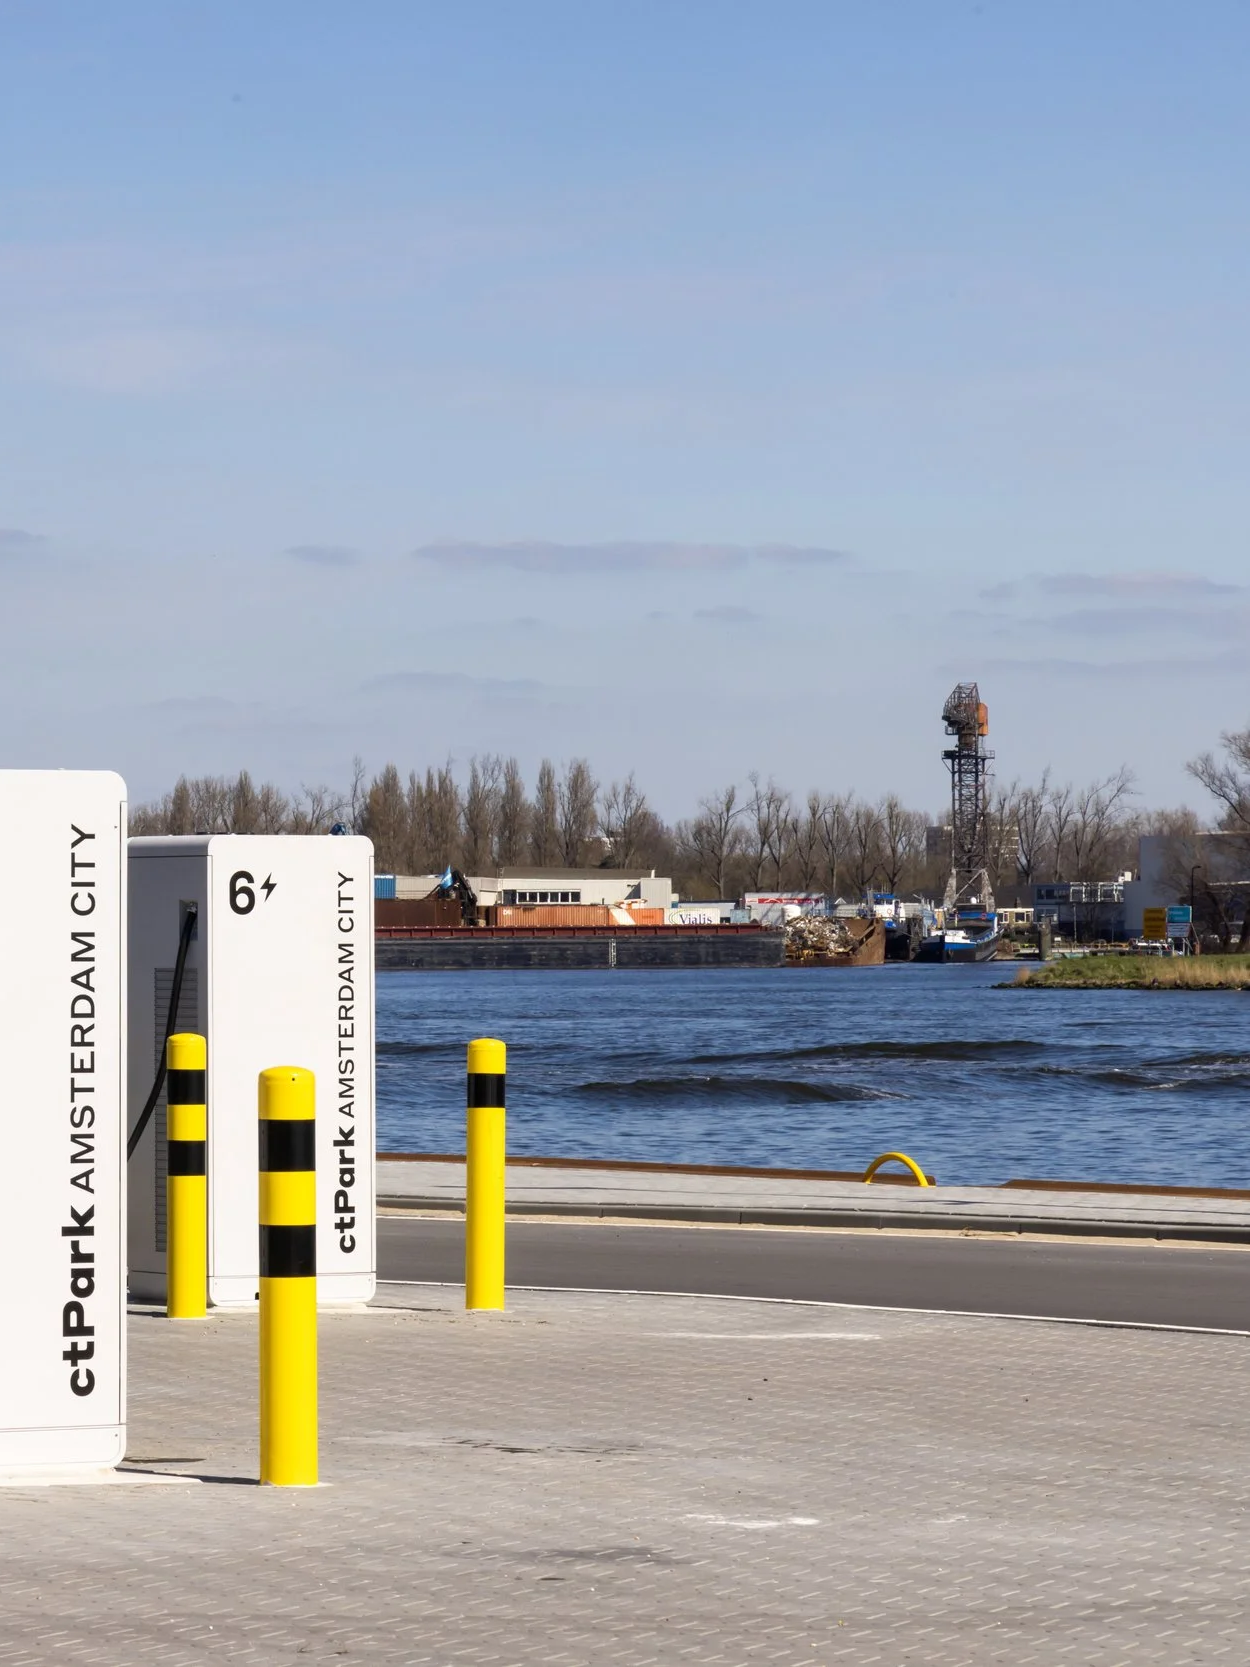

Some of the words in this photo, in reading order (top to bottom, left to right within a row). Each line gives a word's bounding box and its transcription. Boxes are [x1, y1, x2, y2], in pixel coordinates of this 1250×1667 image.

[70, 824, 96, 916] CITY
[229, 870, 256, 916] 6
[337, 871, 354, 933] CITY
[679, 913, 713, 924] Vialis
[70, 932, 96, 1195] AMSTERDAM
[337, 943, 355, 1119] AMSTERDAM
[333, 1125, 356, 1254] ctPark
[61, 1204, 96, 1397] ctPark
